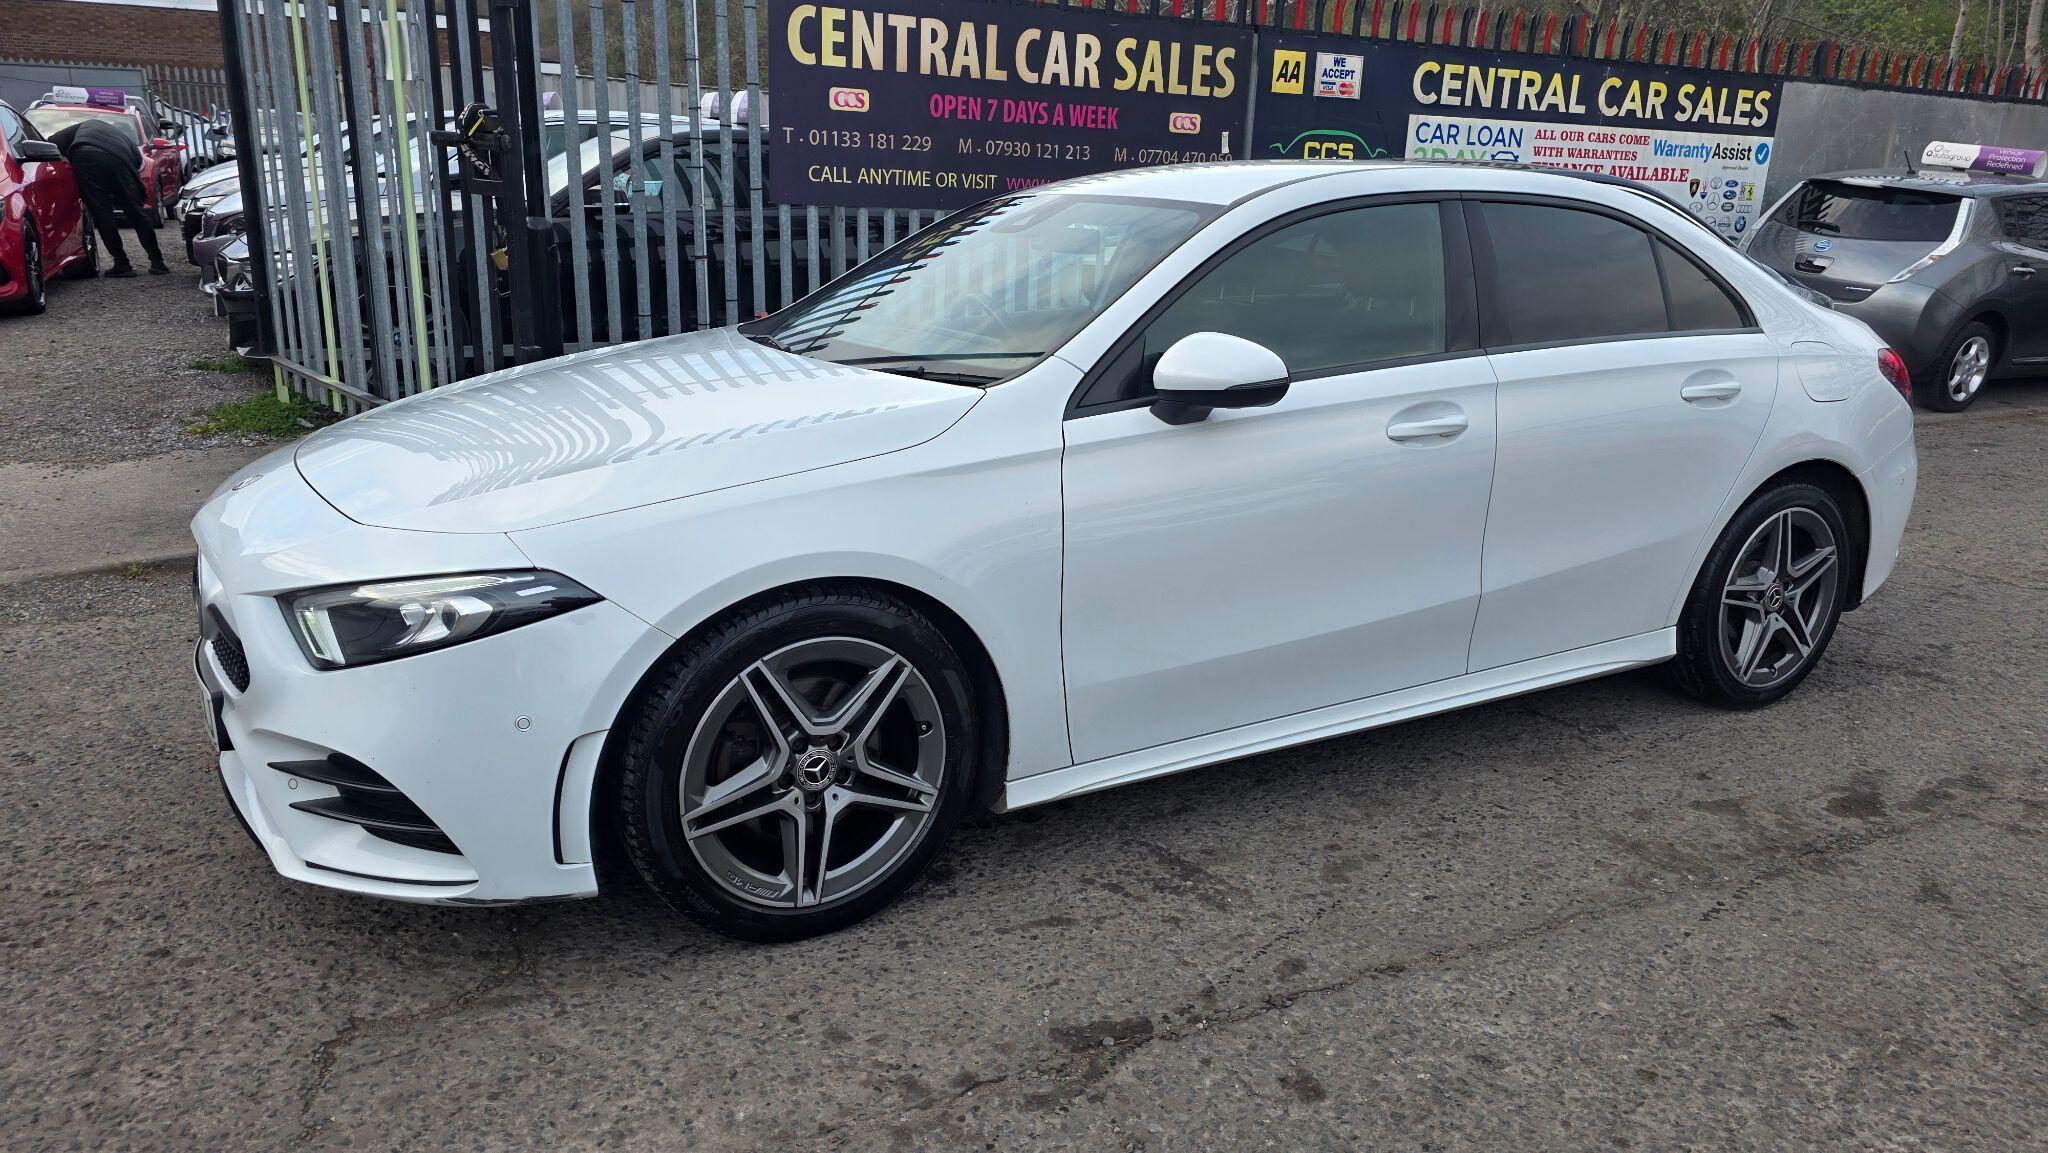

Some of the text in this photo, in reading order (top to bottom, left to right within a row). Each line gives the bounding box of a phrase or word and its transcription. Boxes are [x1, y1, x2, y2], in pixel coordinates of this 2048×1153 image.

[787, 4, 1236, 99] CENTRAL CAR SALES
[1333, 56, 1346, 67] WE
[1276, 60, 1301, 83] AA
[1322, 68, 1355, 80] ACCEPT
[833, 90, 866, 109] CCS
[1413, 61, 1771, 127] CENTRAL CAR SALES
[929, 93, 1119, 129] OPEN 7 DAYS A WEEK
[1172, 115, 1198, 131] CCS
[1415, 121, 1523, 148] CAR LOAN
[1534, 129, 1650, 146] ALL OUR CARS COME
[809, 129, 861, 148] 01133
[868, 132, 895, 149] 181
[901, 134, 932, 152] 229
[986, 140, 1031, 157] 07930
[1035, 143, 1059, 159] 121
[1065, 144, 1090, 160] 213
[1139, 148, 1179, 164] 07704
[1182, 151, 1206, 164] 470
[1303, 141, 1354, 160] CCS
[1532, 146, 1638, 161] WITH WARRANTIES
[1986, 160, 2024, 171] Redefined
[1988, 154, 2026, 163] Protection
[808, 165, 852, 183] CALL
[857, 167, 931, 187] ANYTIME
[935, 172, 957, 188] OR
[961, 174, 998, 190] VISIT
[1608, 165, 1690, 182] AVAILABLE
